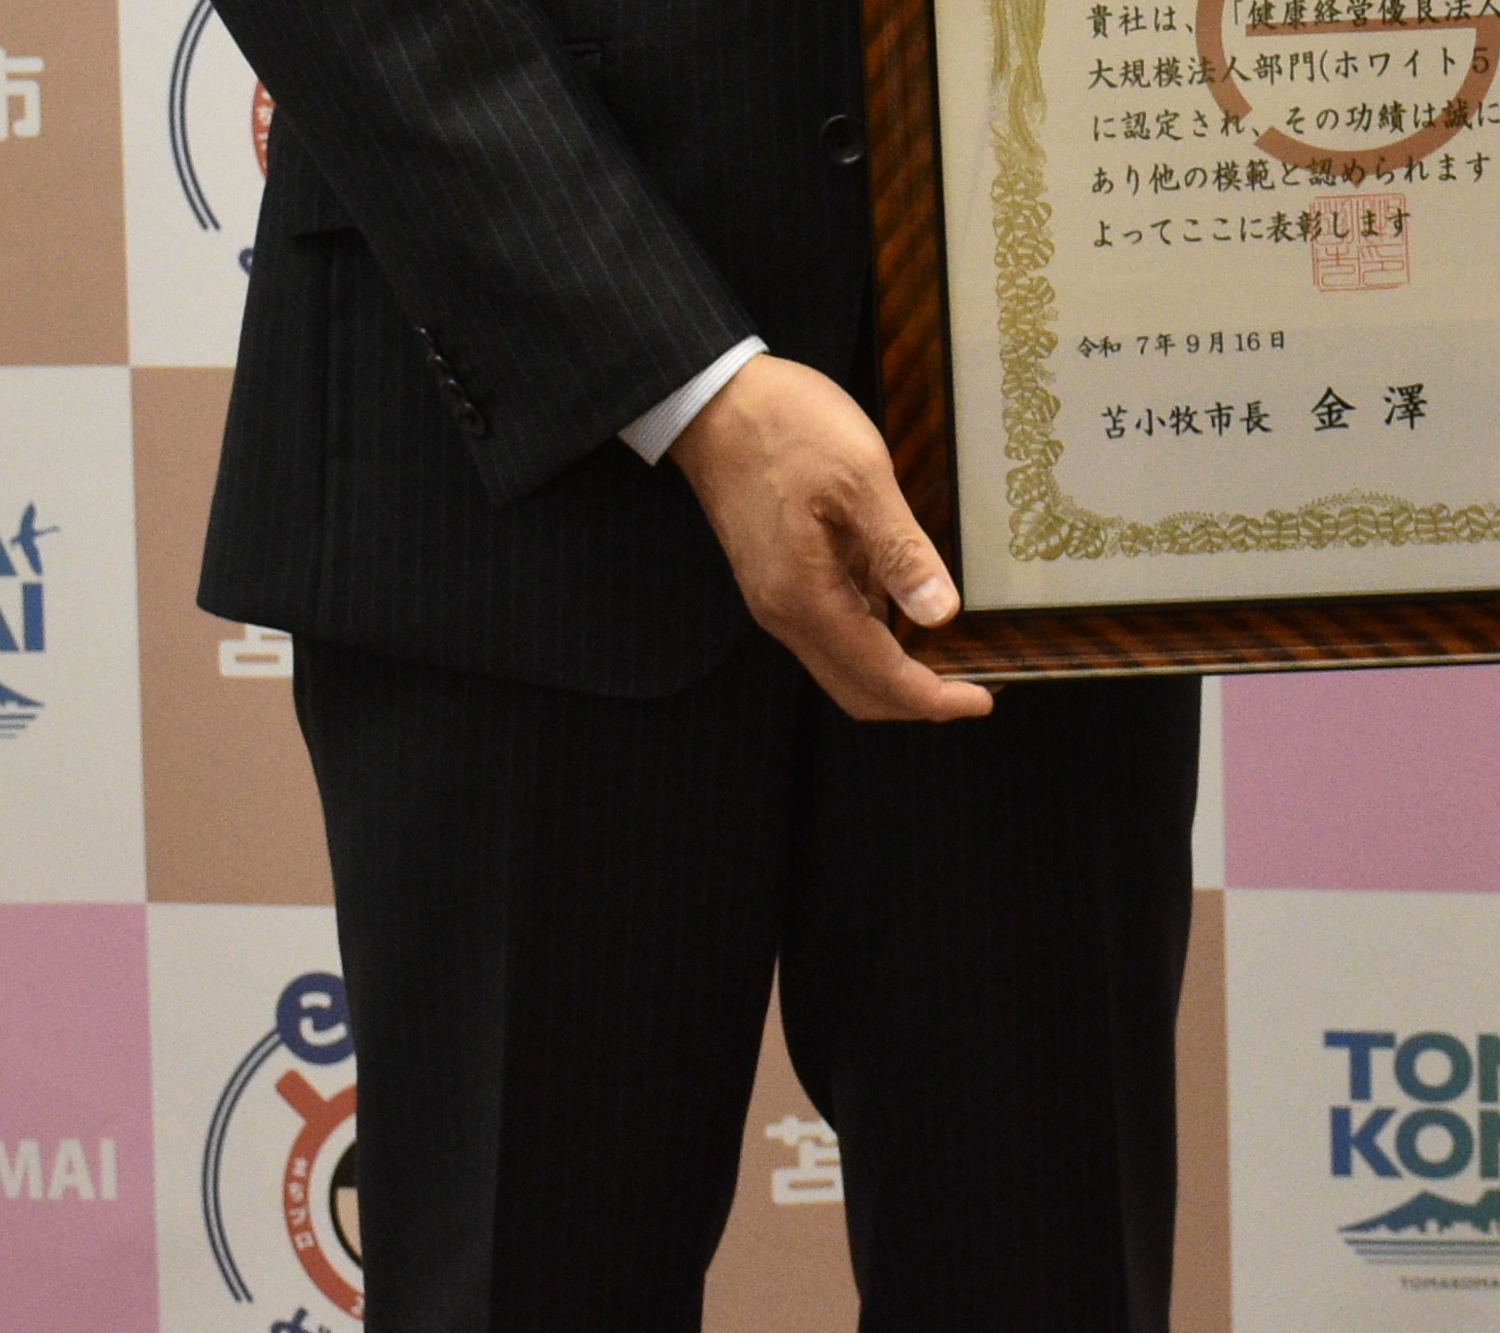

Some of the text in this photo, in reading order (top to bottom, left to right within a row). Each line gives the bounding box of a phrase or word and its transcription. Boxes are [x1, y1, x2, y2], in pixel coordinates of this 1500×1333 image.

[1091, 151, 1491, 195] あり他の模範と認められます
[1091, 206, 1412, 248] よってここに表彰します
[1101, 400, 1273, 439] 苫小牧市長
